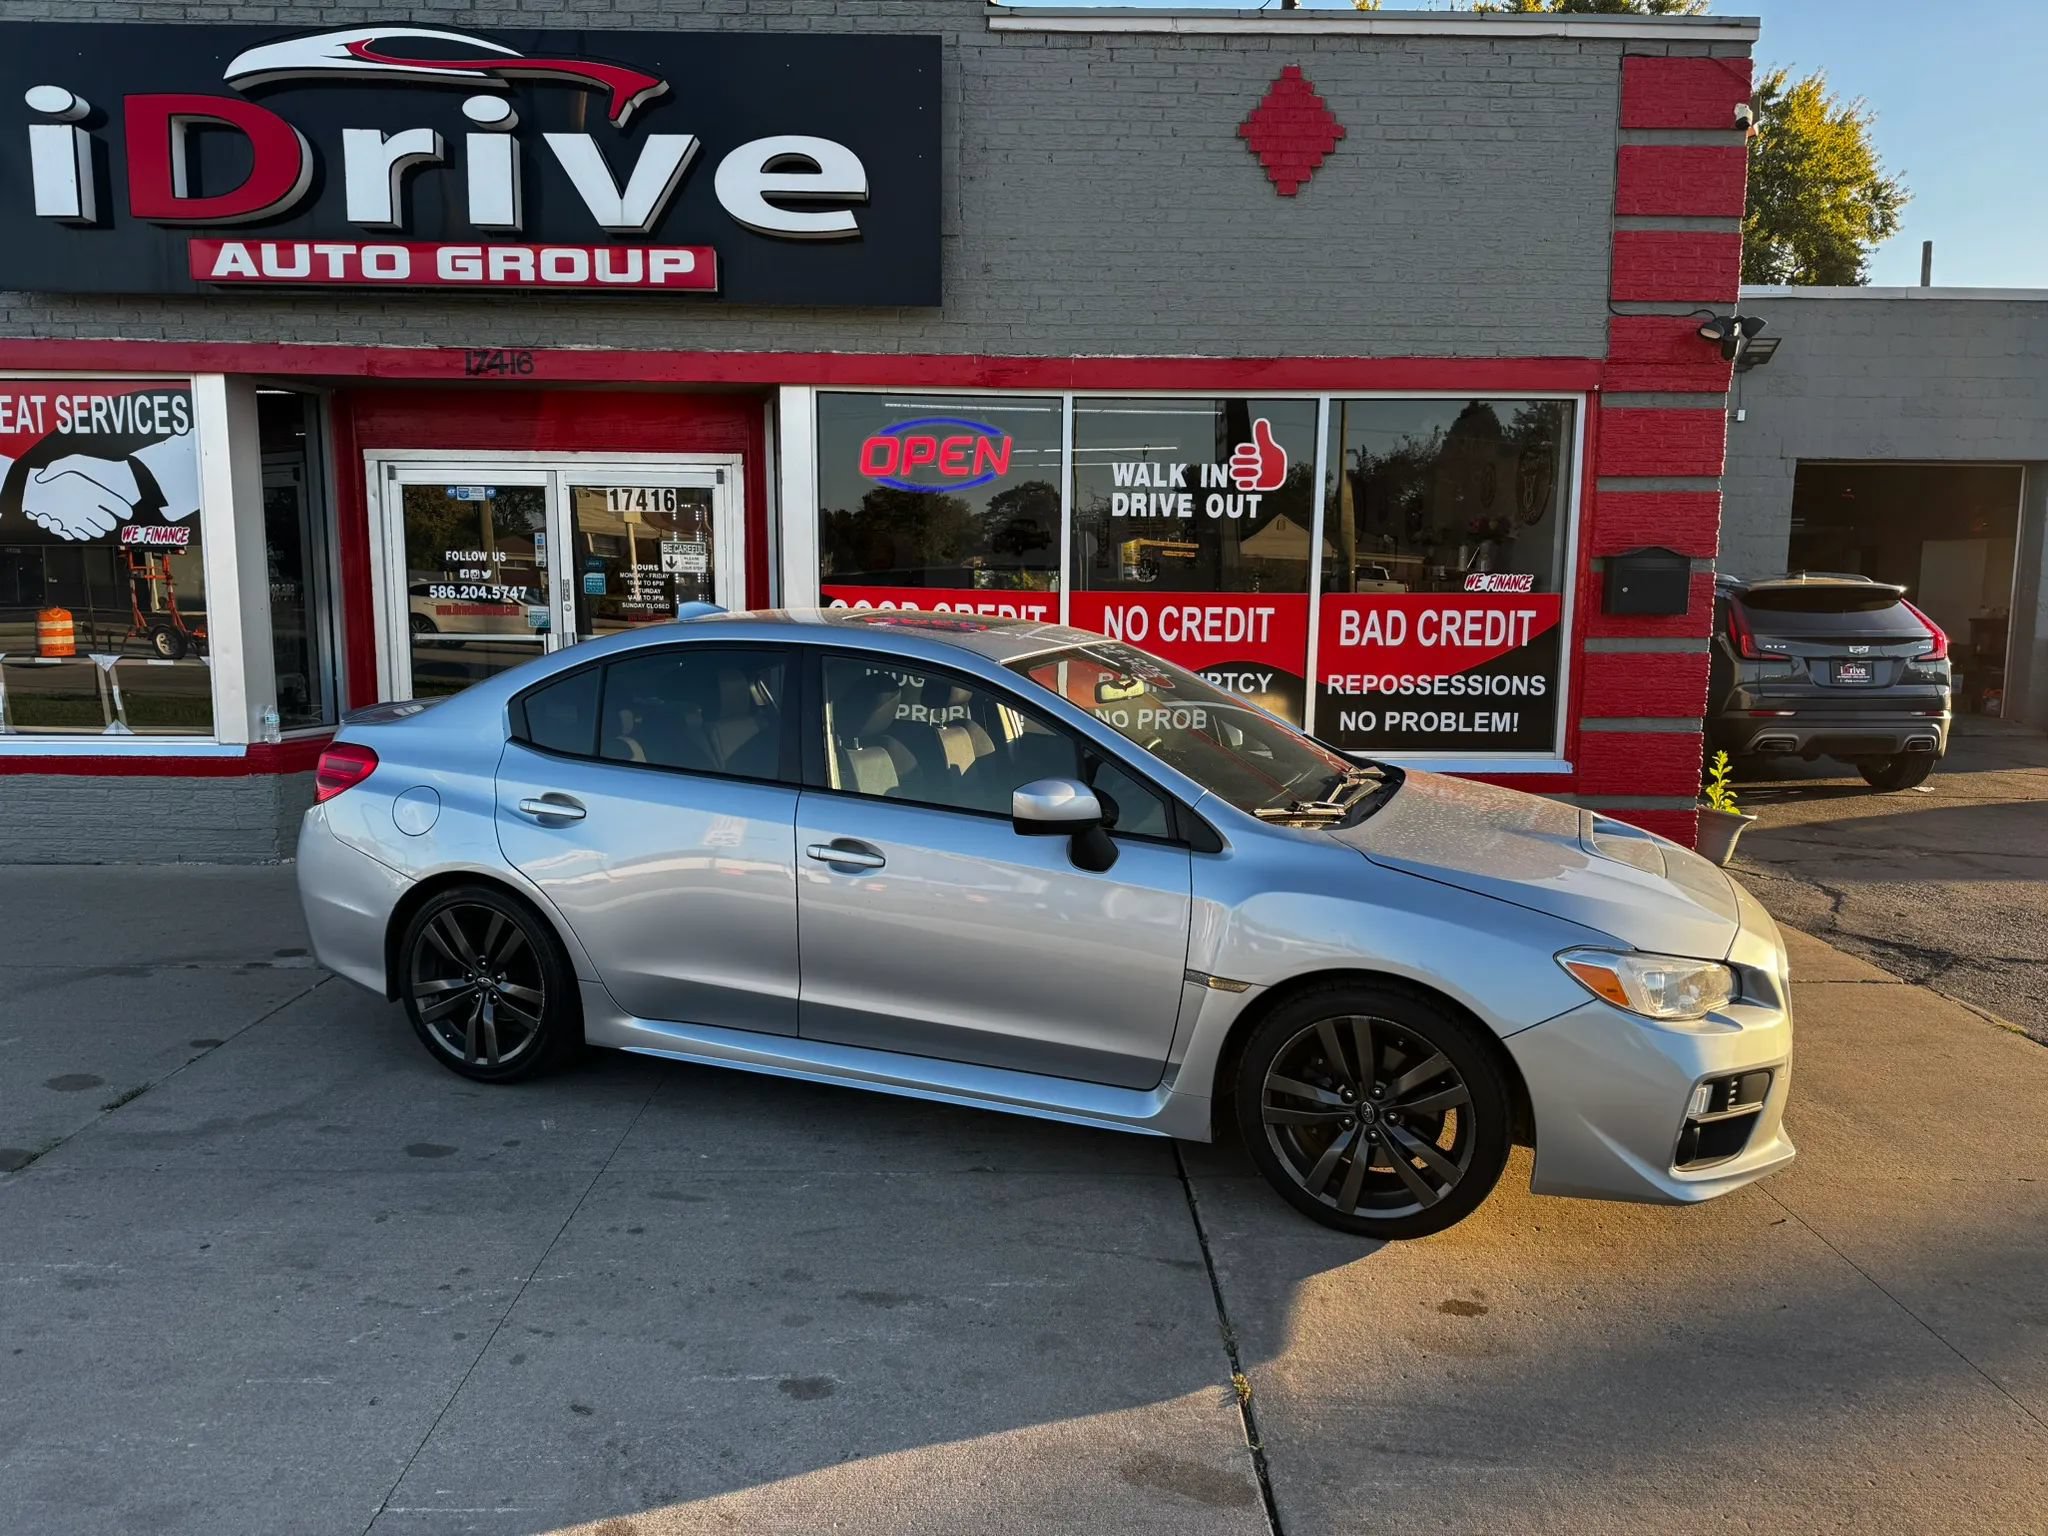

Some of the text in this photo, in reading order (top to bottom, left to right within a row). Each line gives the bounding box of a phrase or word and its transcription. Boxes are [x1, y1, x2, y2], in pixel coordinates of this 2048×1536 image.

[25, 84, 869, 236] iDrive
[212, 241, 697, 285] AUTO GROUP
[465, 351, 534, 375] 17416
[56, 394, 190, 435] SERVICES
[858, 435, 1013, 477] OPEN
[1111, 462, 1228, 489] WALK IN
[610, 489, 675, 511] 17416
[1111, 493, 1262, 519] DRIVE OUT
[121, 525, 190, 545] WE FINANCE
[445, 551, 506, 562] FOLLOW US
[663, 544, 705, 554] BE CAREFUL
[429, 585, 527, 599] 586.204.5747
[1464, 573, 1535, 593] WE FINANCE
[1104, 605, 1275, 643] NO CREDIT
[1339, 609, 1537, 648] BAD CREDIT
[1327, 674, 1546, 696] REPOSSESSIONS
[1095, 709, 1130, 728] NO
[1339, 711, 1519, 733] NO PROBLEM!
